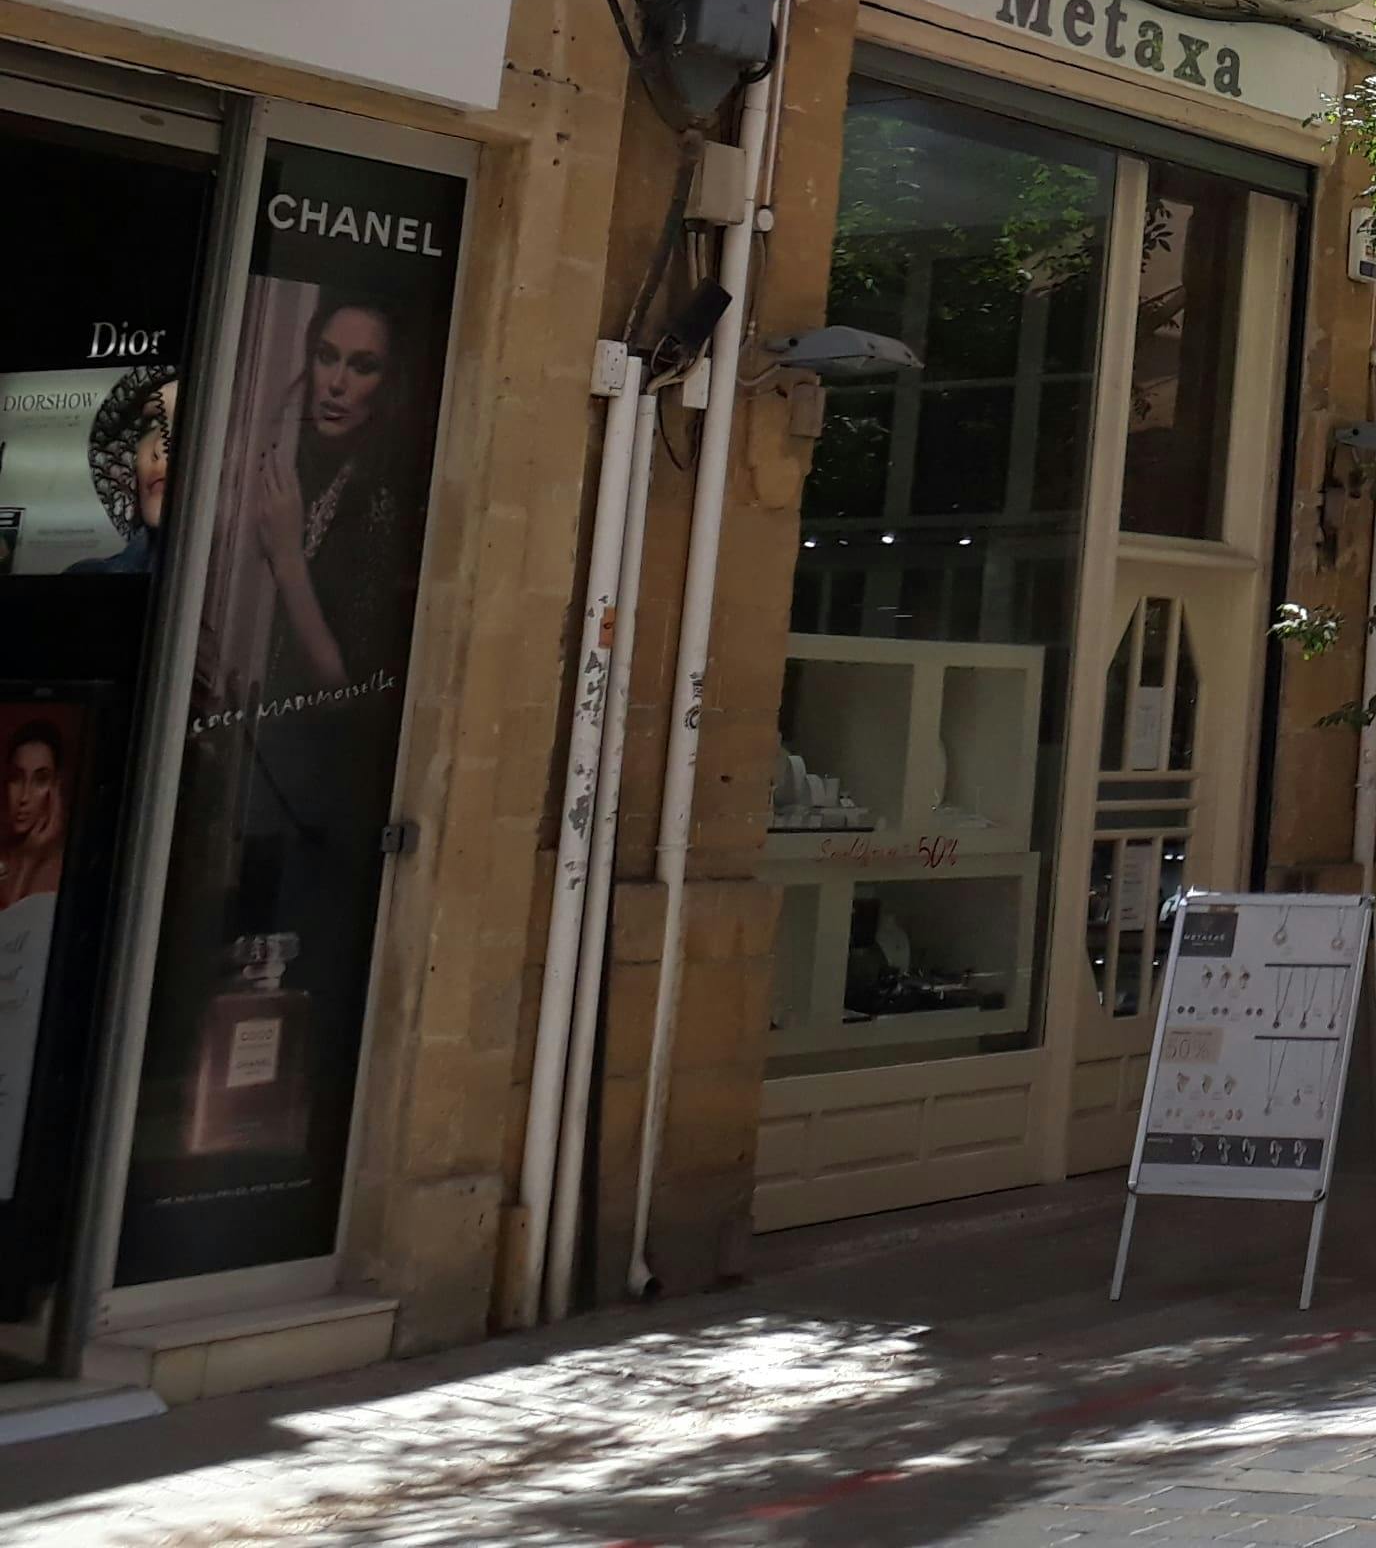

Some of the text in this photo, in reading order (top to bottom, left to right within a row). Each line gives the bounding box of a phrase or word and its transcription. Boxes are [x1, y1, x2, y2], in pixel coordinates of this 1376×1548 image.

[267, 193, 443, 257] CHANEL
[87, 321, 166, 359] Dior
[3, 392, 97, 412] DIORSHOW
